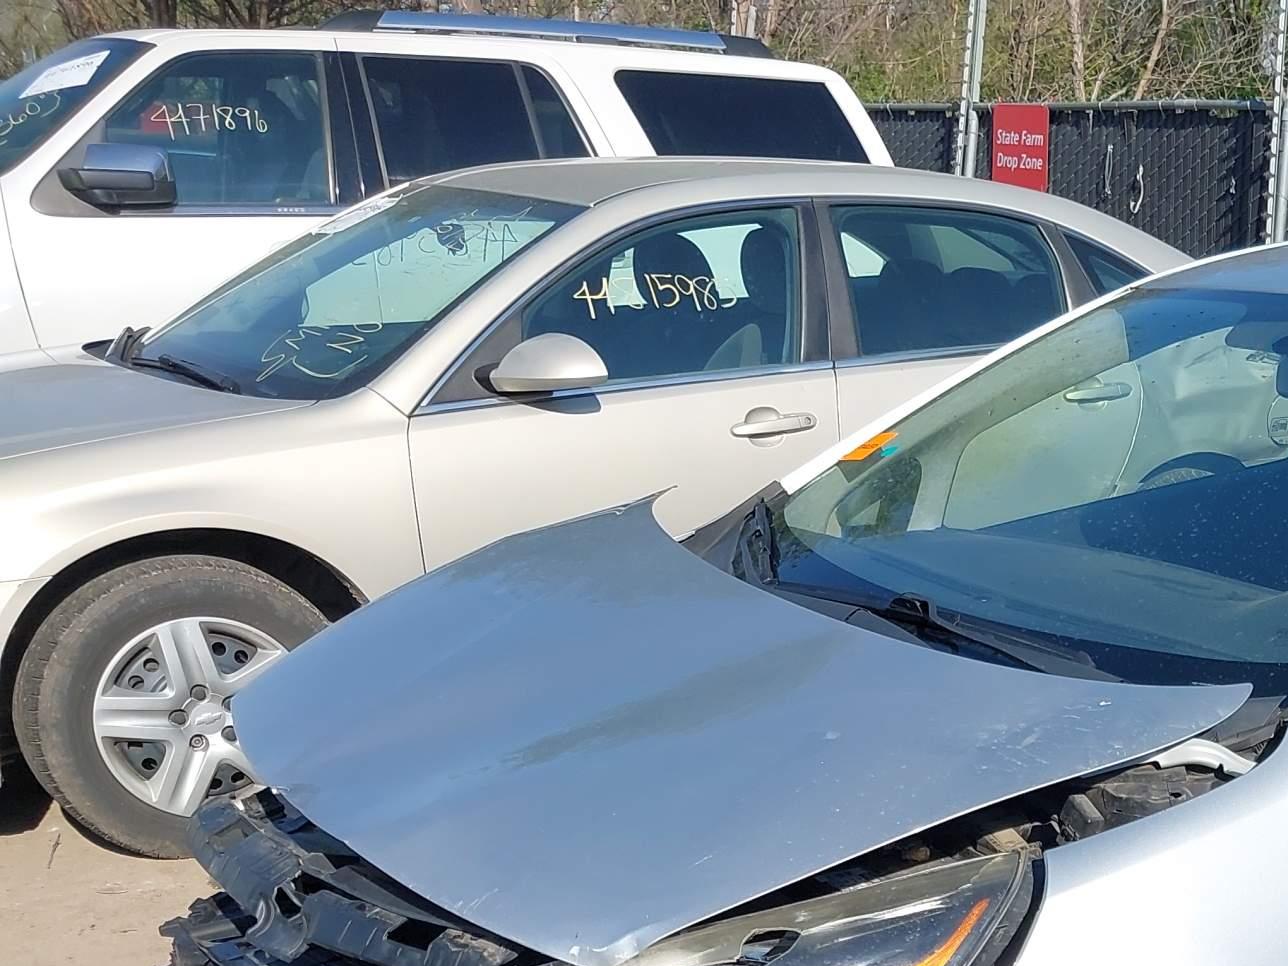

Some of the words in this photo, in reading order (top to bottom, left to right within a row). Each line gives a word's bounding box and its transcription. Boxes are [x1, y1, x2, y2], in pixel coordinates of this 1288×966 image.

[150, 102, 268, 141] 4471896
[996, 128, 1020, 146] State
[1021, 130, 1044, 147] Farm
[996, 152, 1019, 172] Drop
[1019, 153, 1043, 170] Zone
